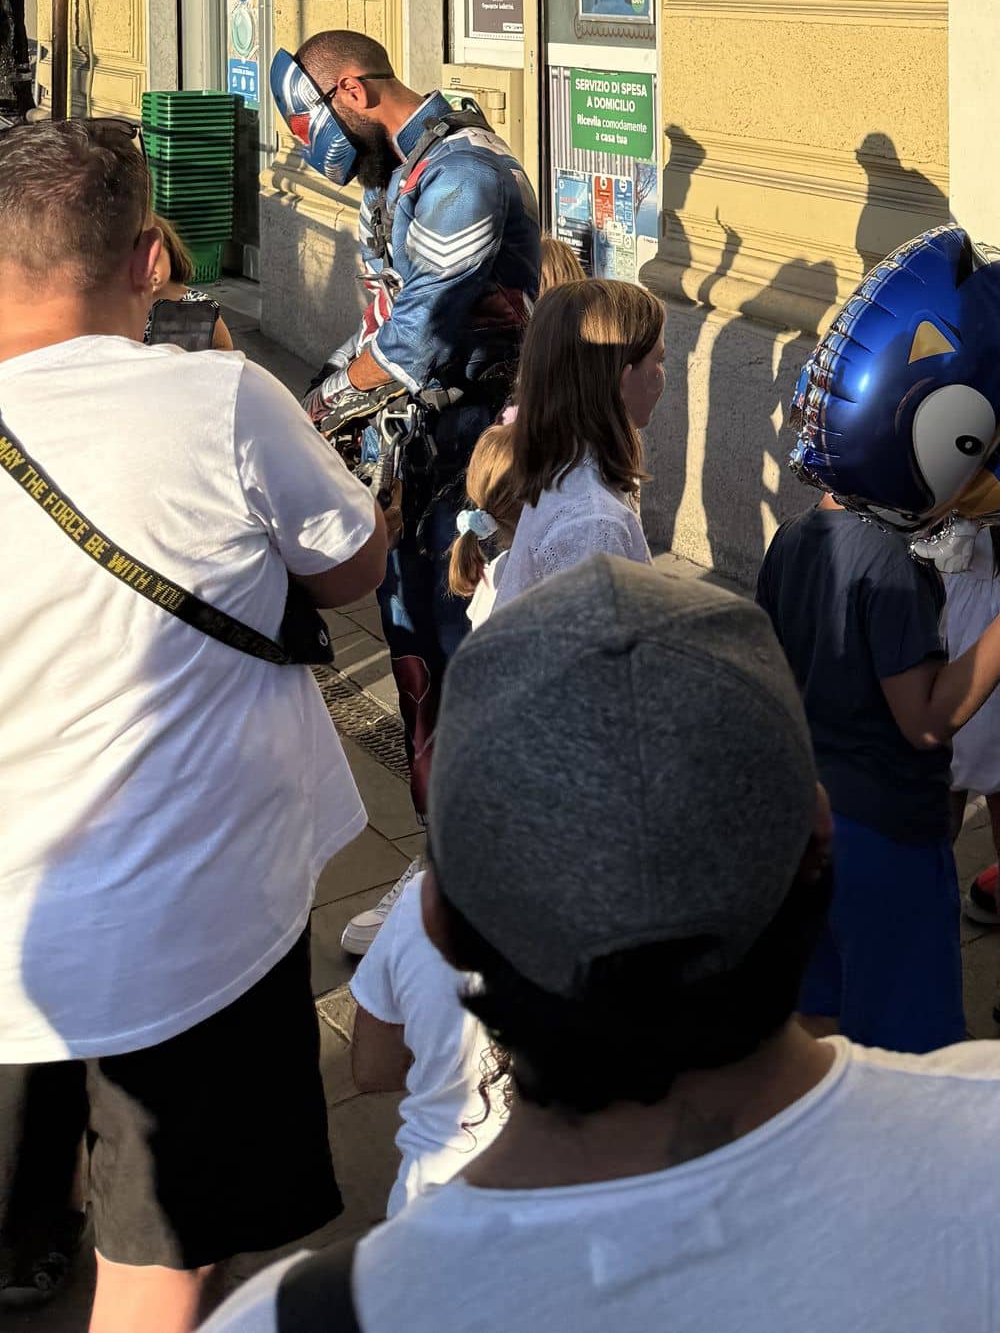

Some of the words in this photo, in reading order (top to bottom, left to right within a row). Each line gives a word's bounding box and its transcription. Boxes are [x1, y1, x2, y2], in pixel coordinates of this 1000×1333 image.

[575, 78, 610, 94] SERVIZIO
[611, 81, 620, 95] DI
[621, 82, 648, 98] SPESA
[586, 95, 593, 108] A
[593, 96, 636, 113] DOMICILIO
[602, 118, 648, 134] comodamente
[595, 132, 600, 142] a
[600, 133, 616, 144] casa
[616, 134, 629, 146] tua
[20, 464, 49, 500] THE
[42, 491, 91, 543] FORCE
[84, 532, 112, 560] BE
[107, 550, 154, 590] WITH
